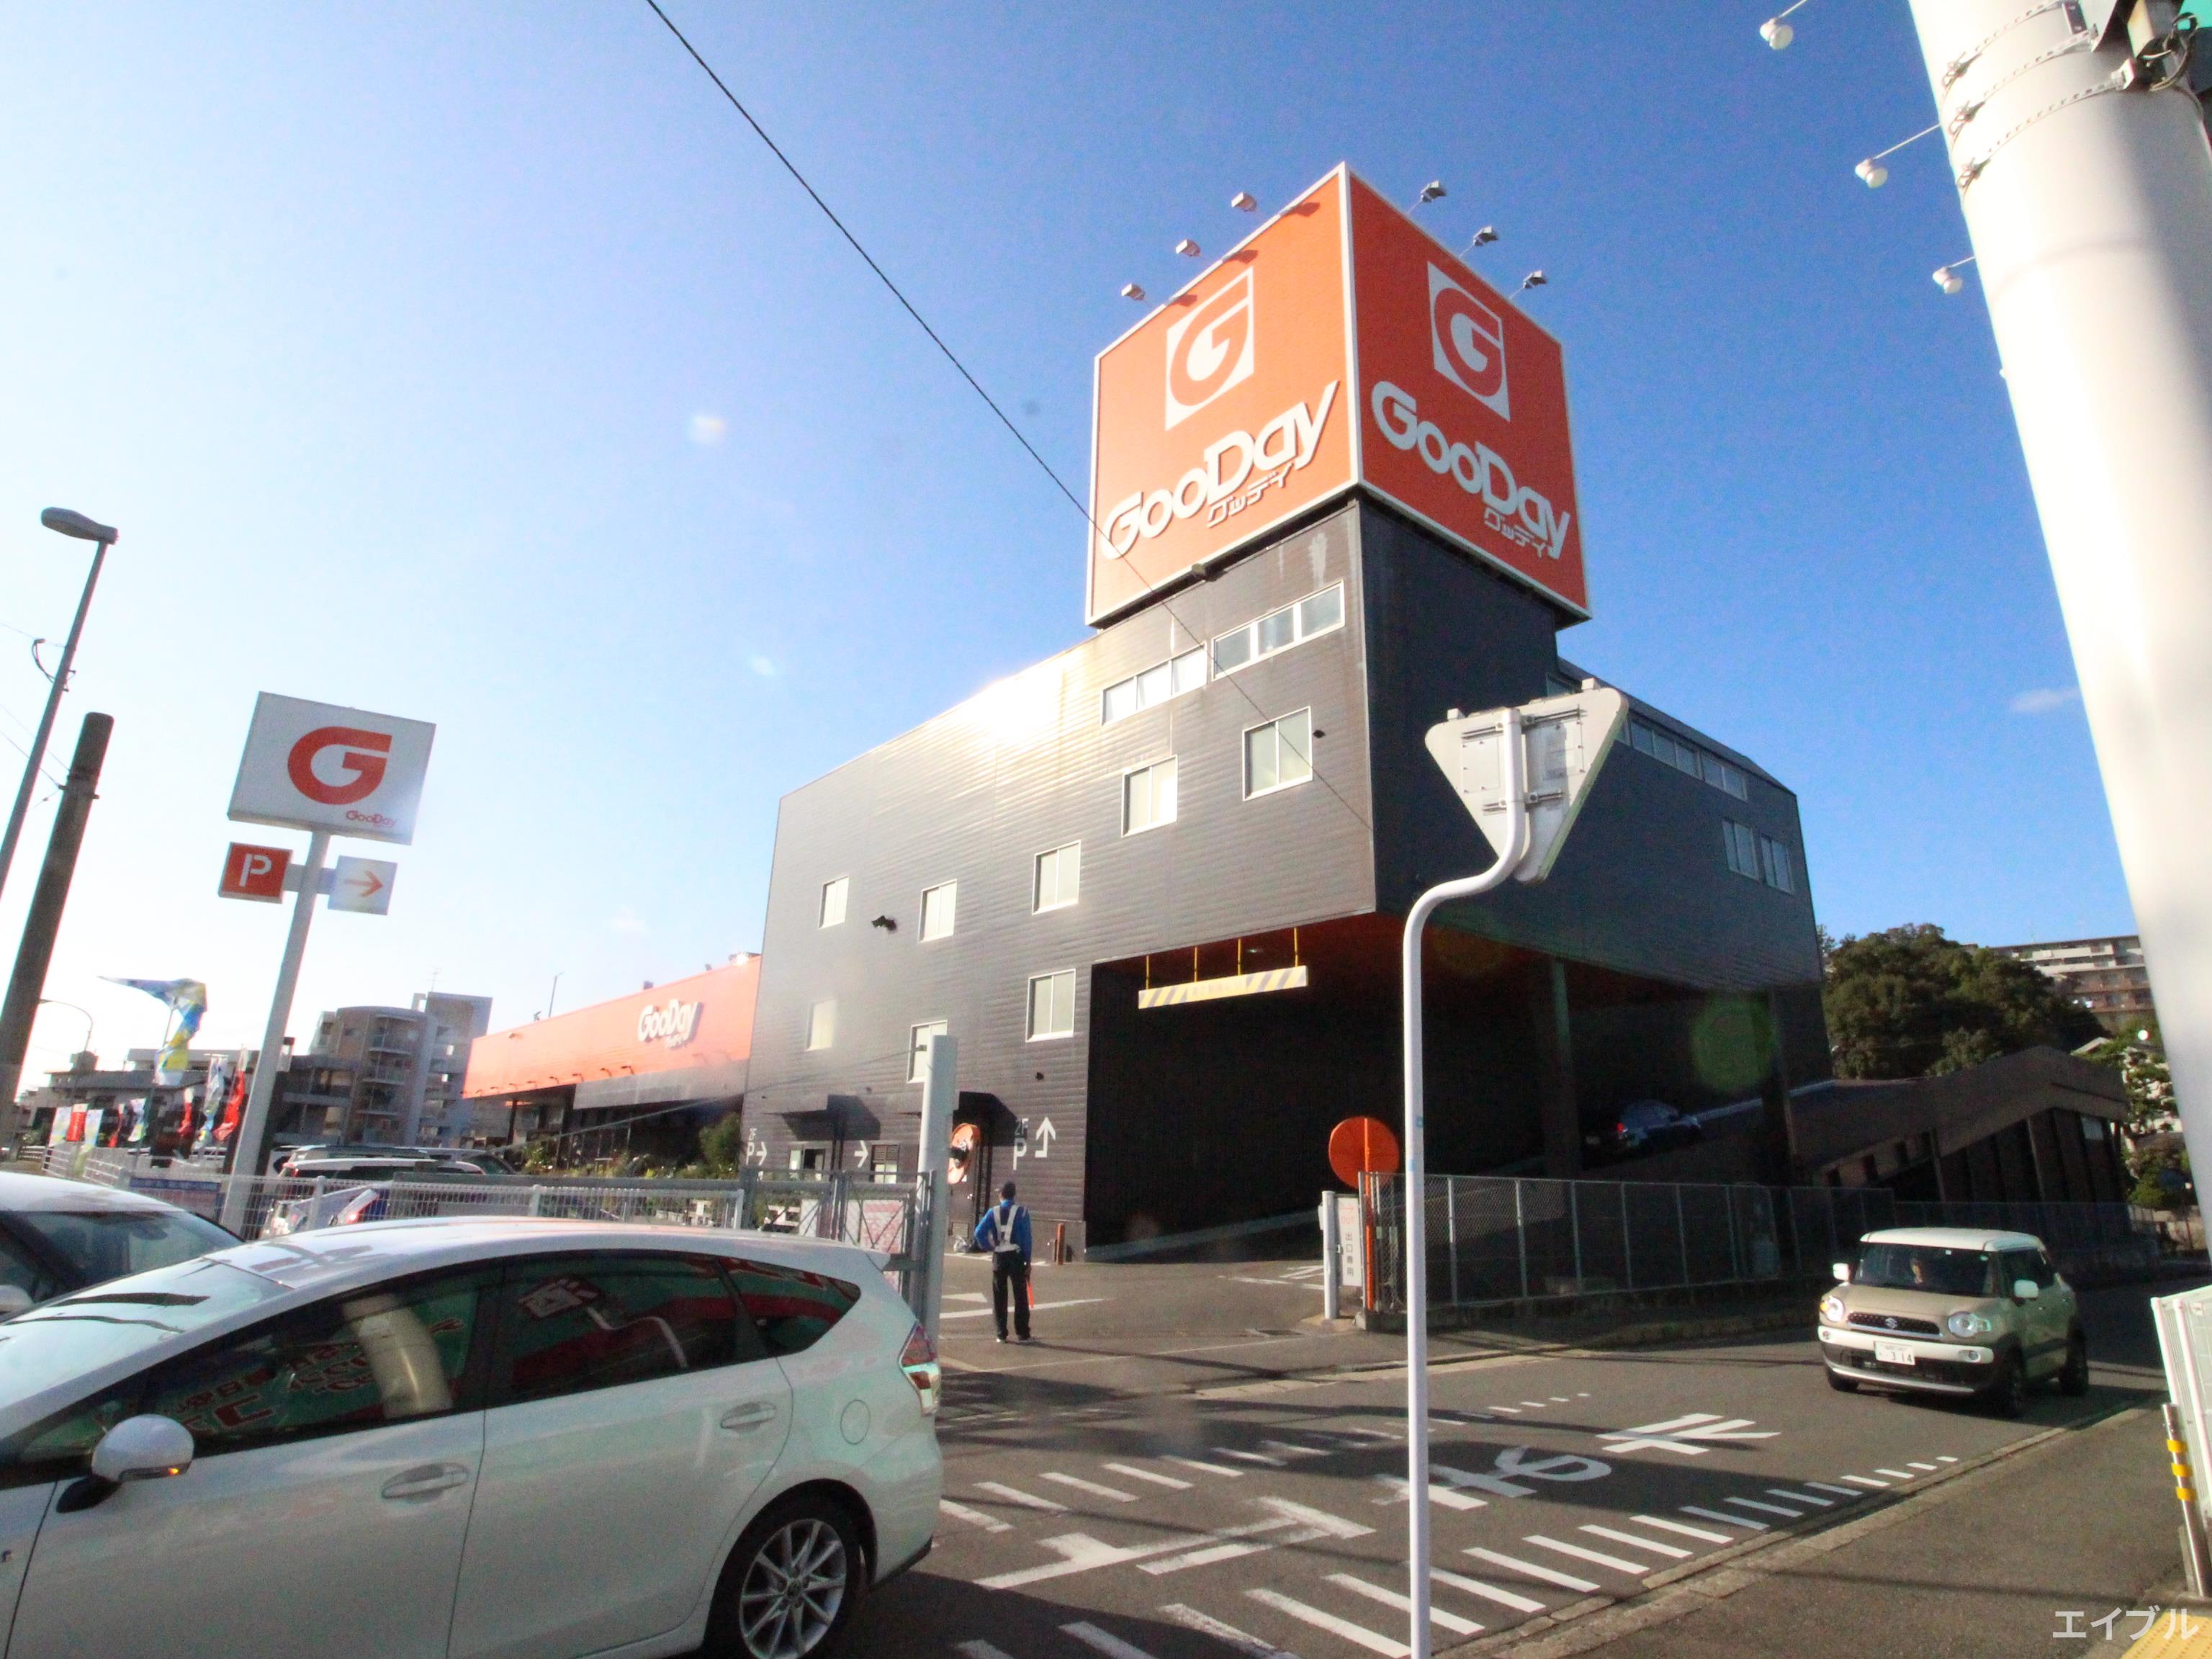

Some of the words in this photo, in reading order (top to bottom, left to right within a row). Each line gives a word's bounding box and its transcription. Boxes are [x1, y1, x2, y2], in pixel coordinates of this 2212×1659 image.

[1169, 272, 1254, 408] G
[1434, 287, 1503, 397] G
[1100, 380, 1339, 560] GooDay
[1372, 381, 1571, 560] GooDay
[288, 726, 392, 806] G
[345, 809, 396, 828] GooDay
[238, 853, 272, 888] P
[637, 998, 699, 1043] GooDay
[1015, 1117, 1030, 1136] 2F
[745, 1141, 755, 1166] P
[1012, 1137, 1028, 1172] P
